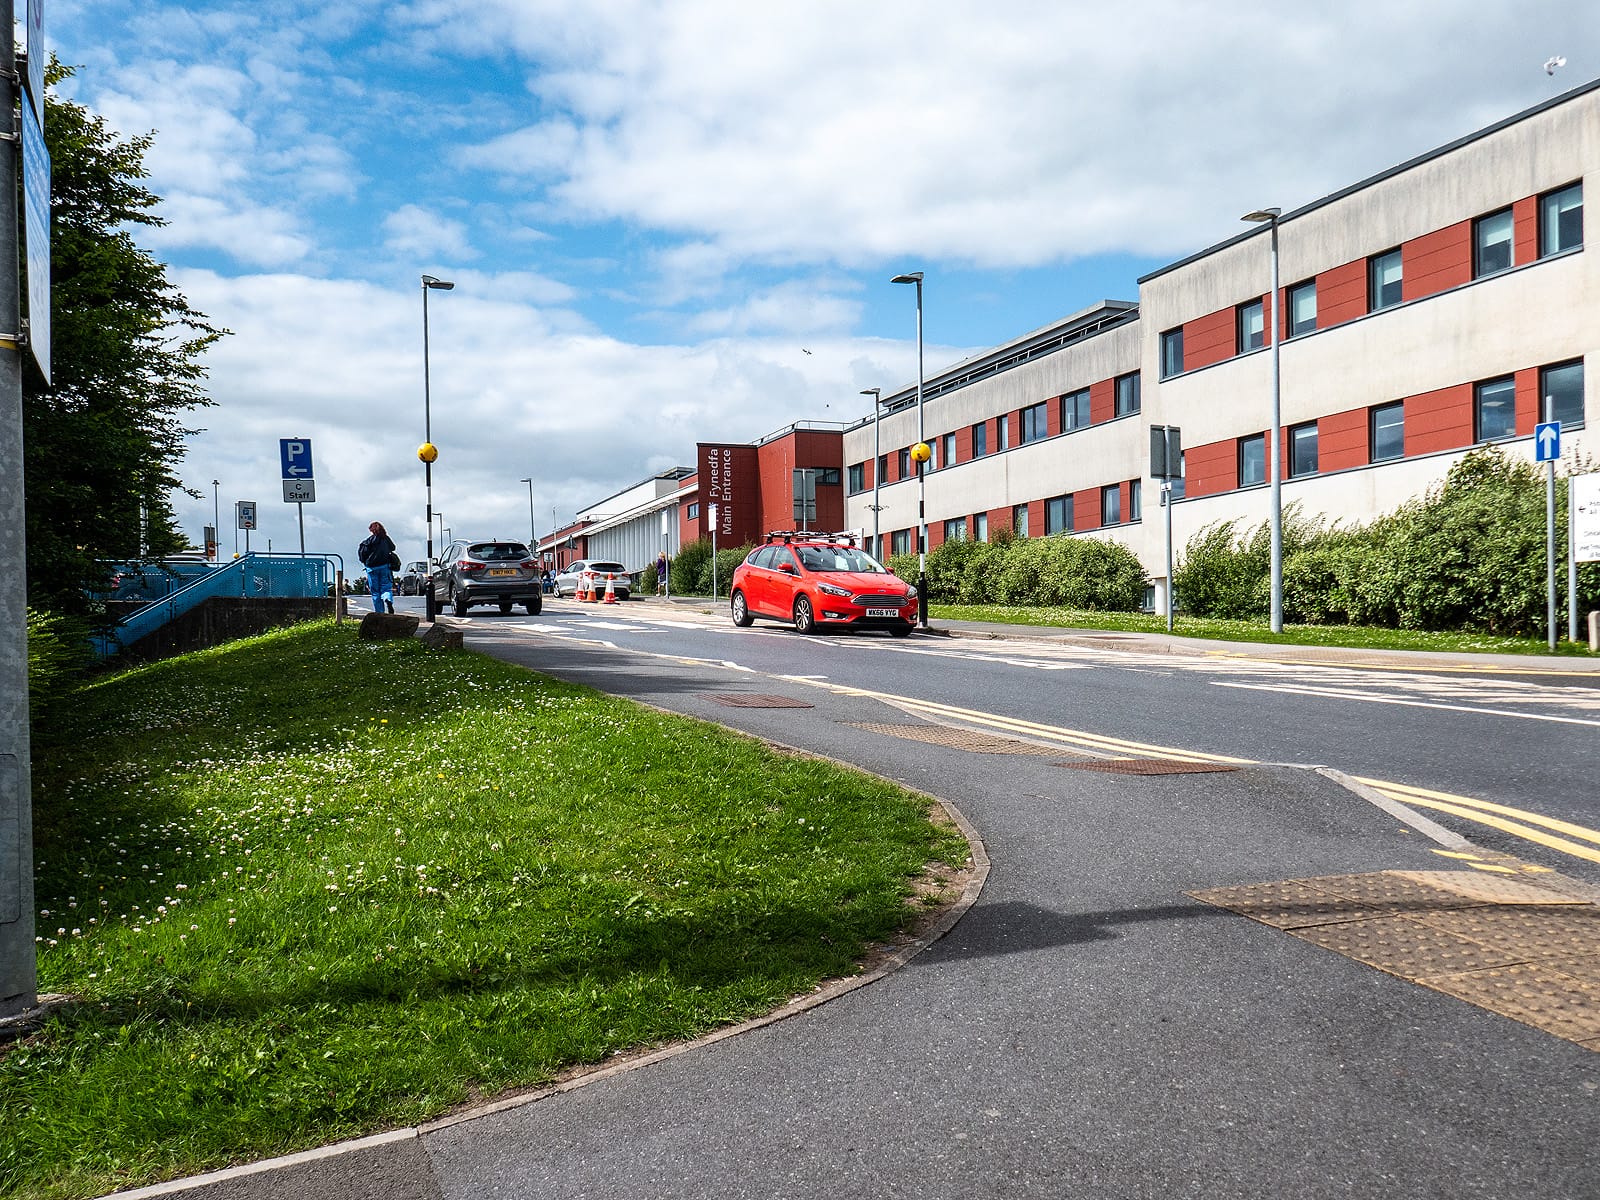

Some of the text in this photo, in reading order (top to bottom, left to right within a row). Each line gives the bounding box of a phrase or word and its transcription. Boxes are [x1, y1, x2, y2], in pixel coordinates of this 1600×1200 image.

[287, 442, 304, 462] P
[708, 448, 721, 497] Fynedfa
[289, 491, 310, 499] Staff
[295, 483, 302, 491] C
[722, 449, 732, 535] Main Entrance
